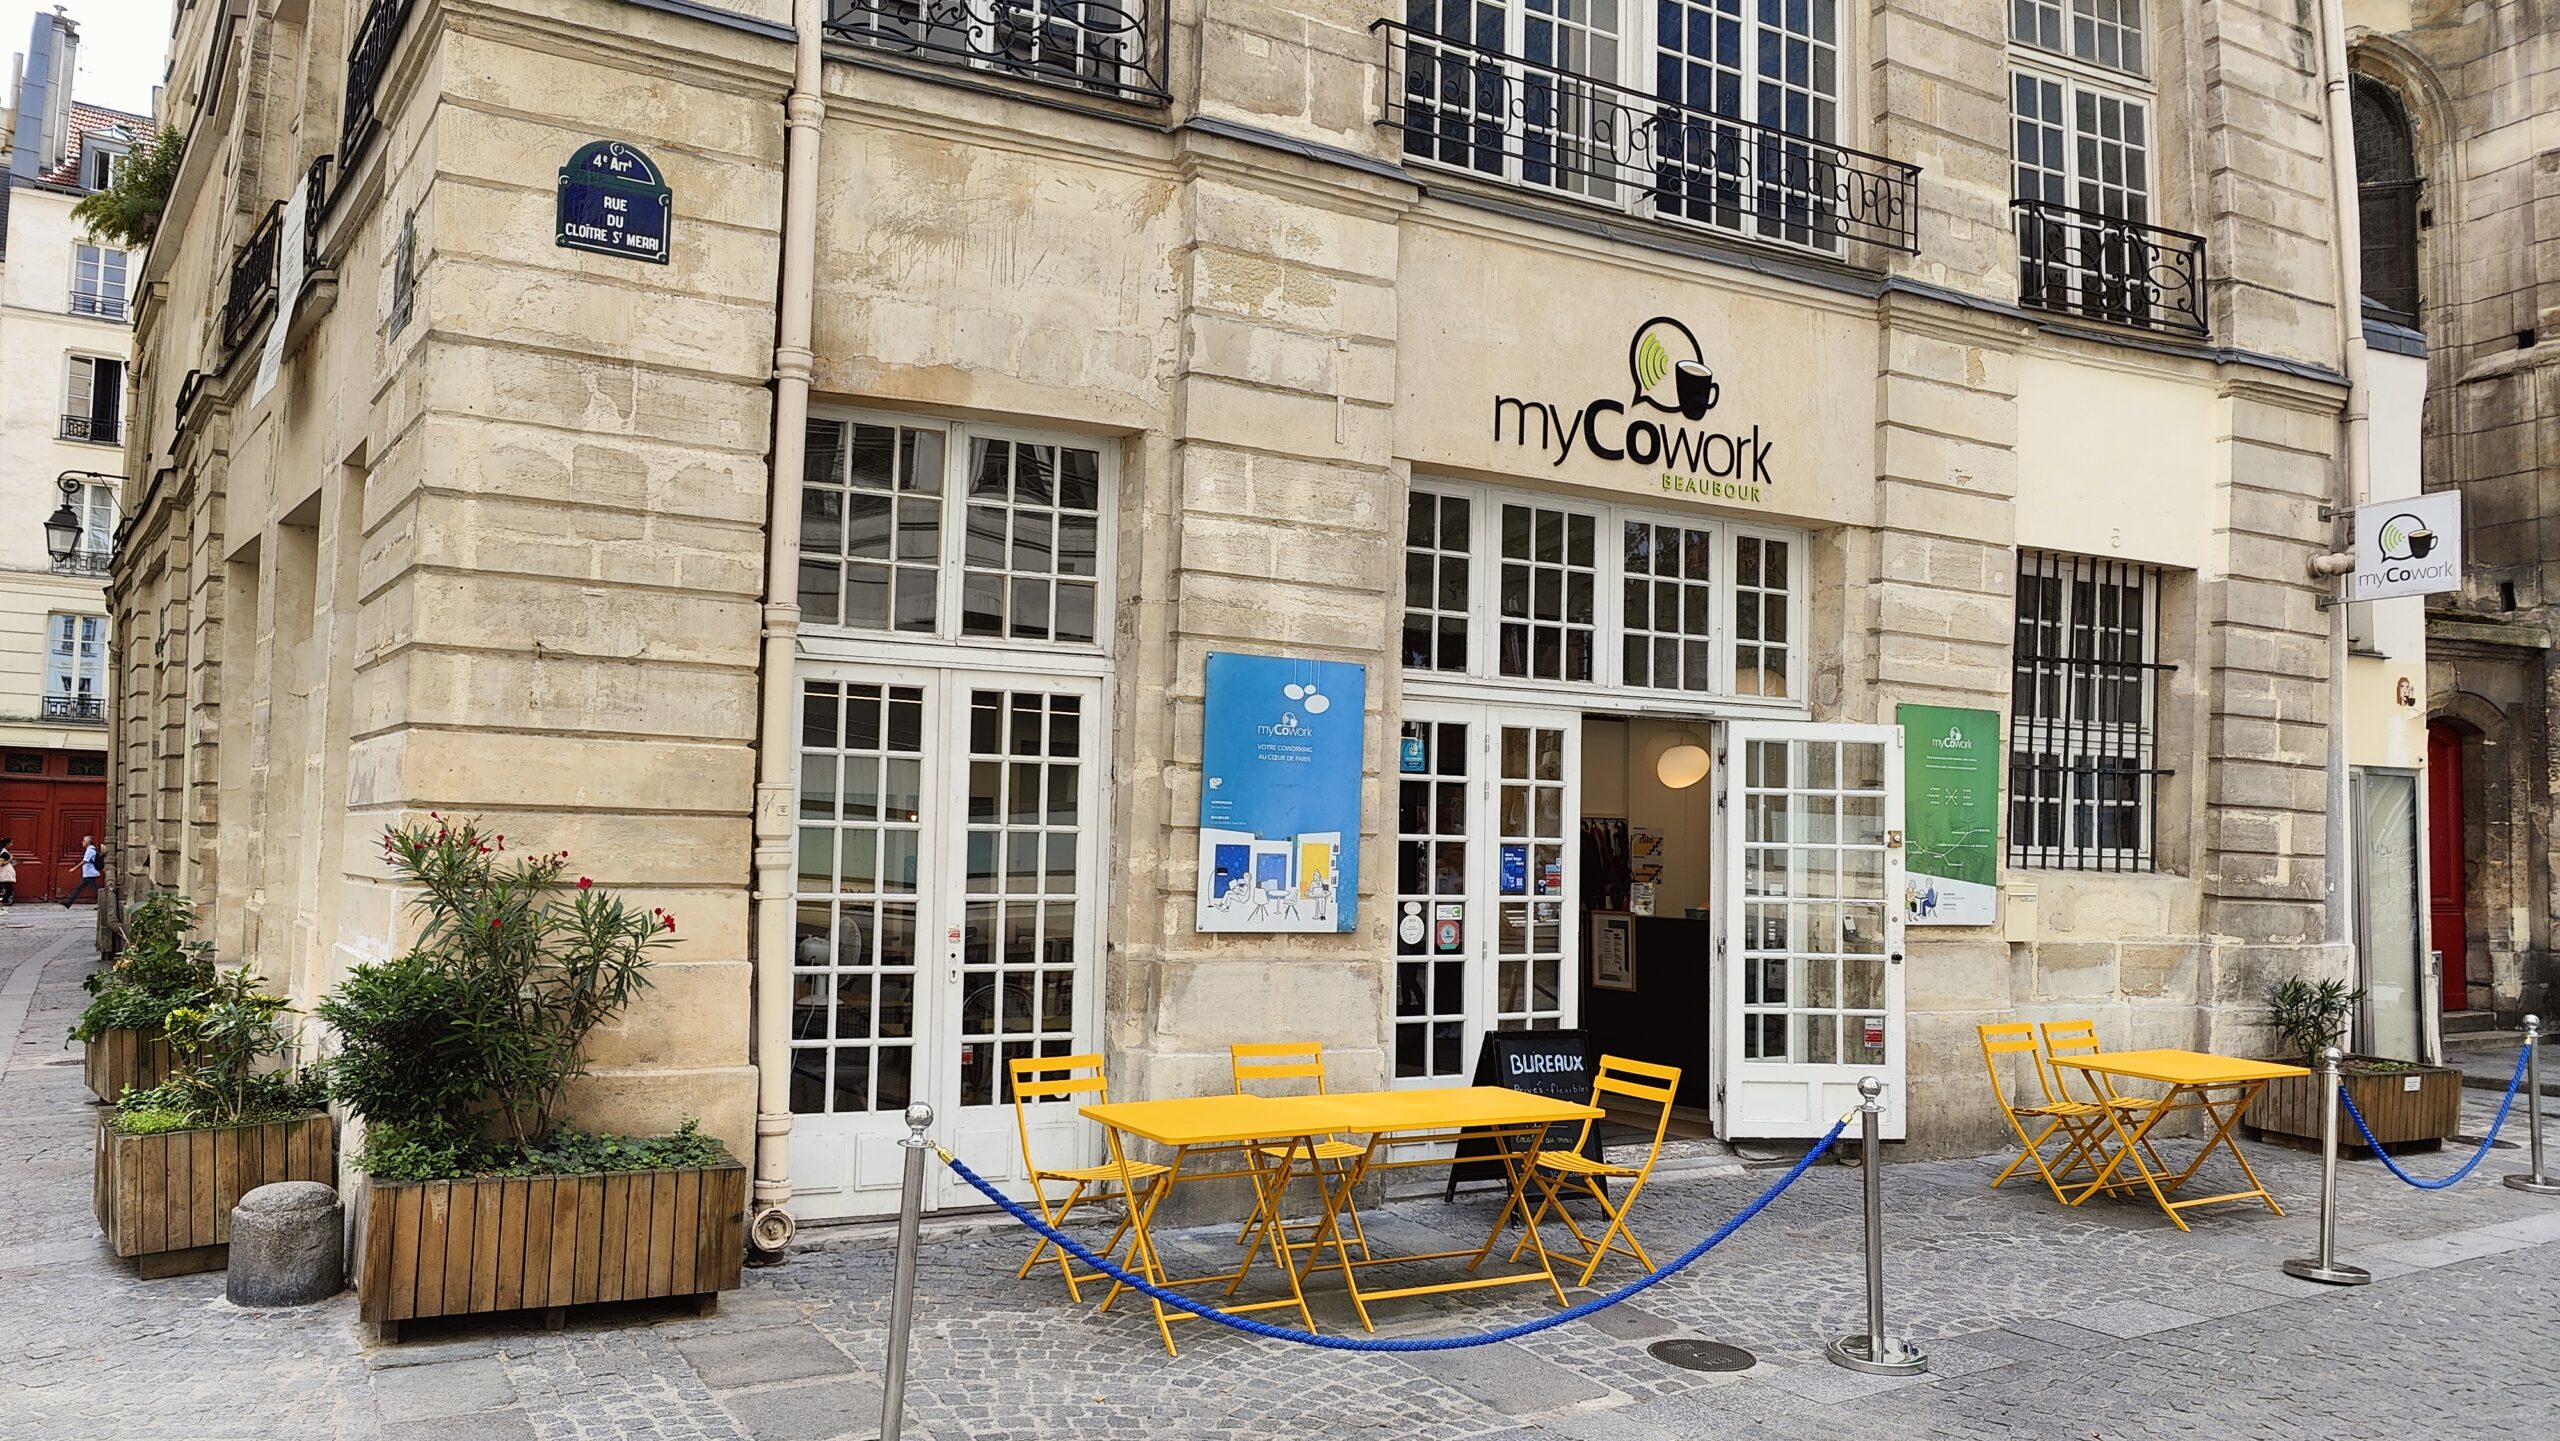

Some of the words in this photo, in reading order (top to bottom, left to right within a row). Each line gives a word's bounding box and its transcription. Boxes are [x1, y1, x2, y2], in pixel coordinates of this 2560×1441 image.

[604, 196, 628, 212] RUE
[607, 214, 624, 228] DU
[565, 222, 608, 242] CLOÎTRE
[626, 234, 659, 251] MERRI
[1494, 395, 1772, 484] myCowork
[2359, 561, 2454, 588] myCowork
[1257, 724, 1313, 737] myCowork
[1278, 745, 1313, 753] COWORKING
[1932, 738, 1972, 750] myCowork
[1510, 1054, 1584, 1075] BUREAUX
